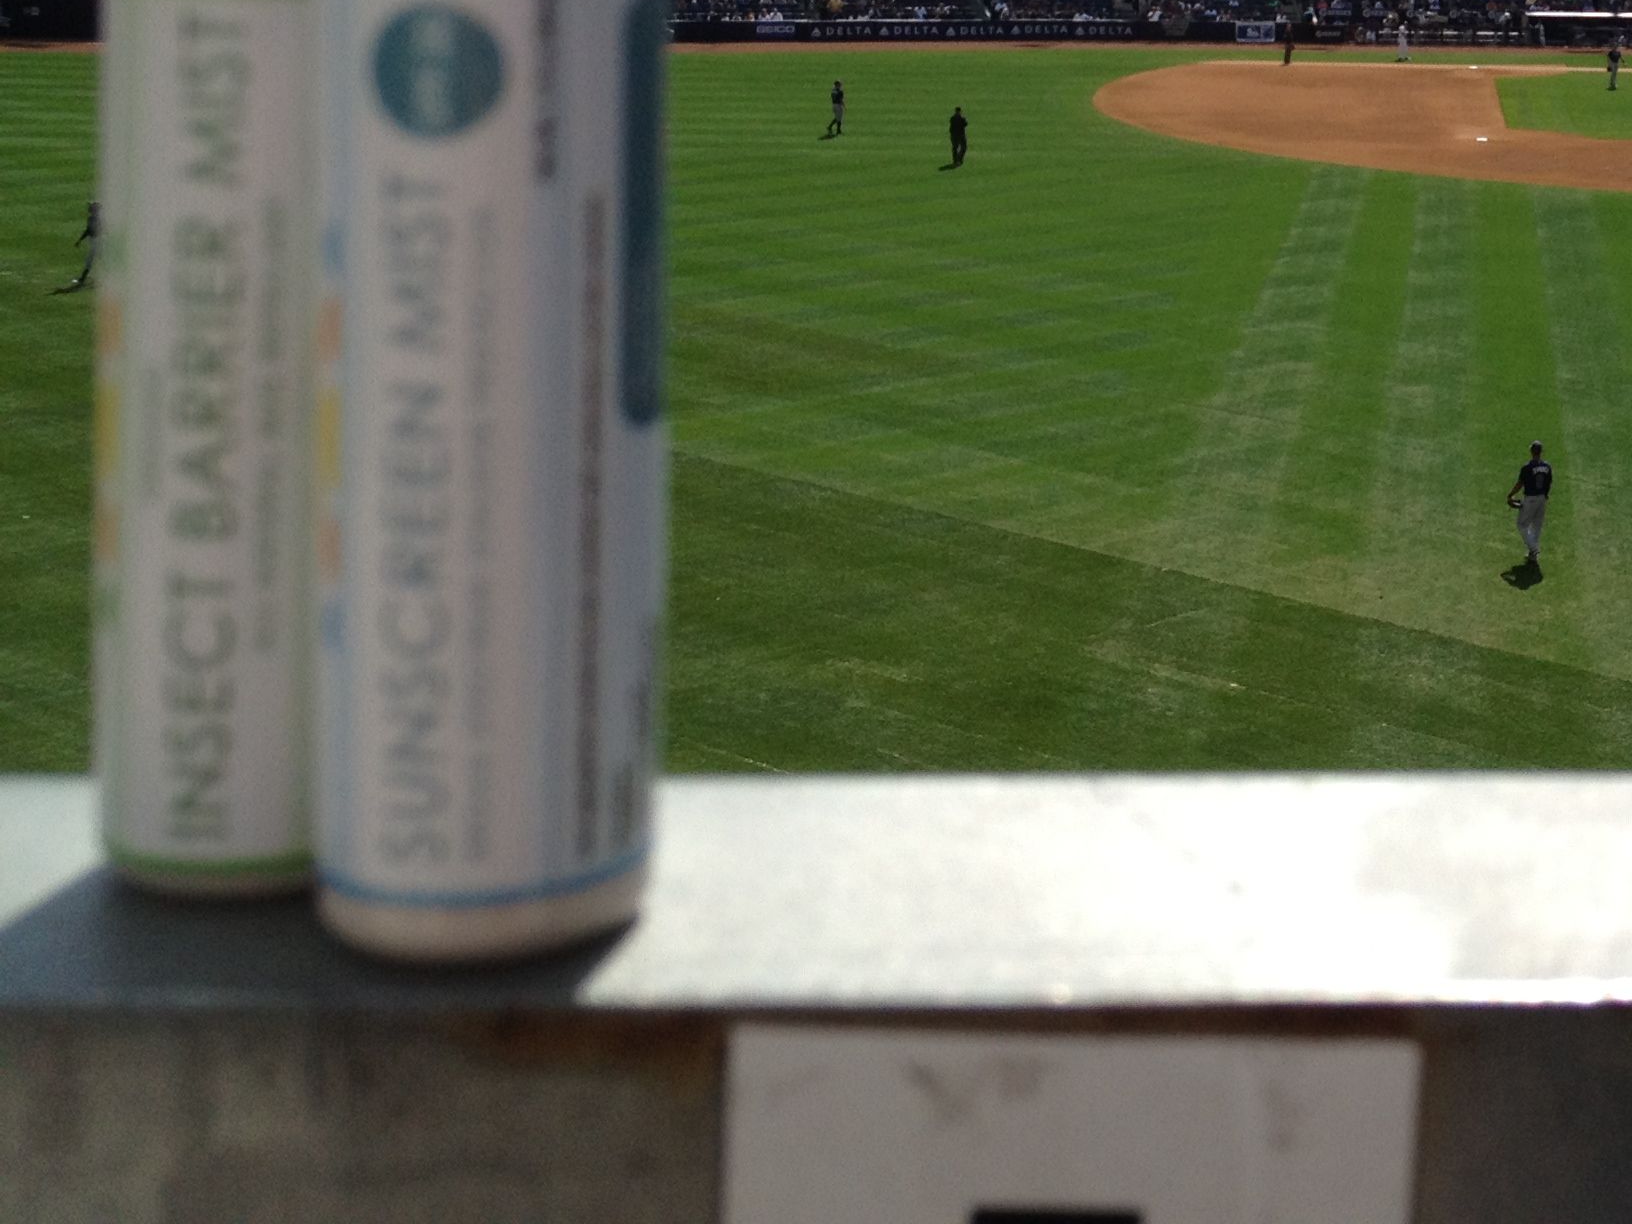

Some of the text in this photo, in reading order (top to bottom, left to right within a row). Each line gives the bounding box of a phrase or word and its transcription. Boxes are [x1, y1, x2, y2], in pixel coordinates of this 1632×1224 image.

[756, 26, 795, 34] GEICO
[825, 26, 1133, 36] DELTA DELTA DELTA DELTA DELTA
[376, 380, 453, 863] SUNSCREEN
[163, 572, 238, 843] INSECT
